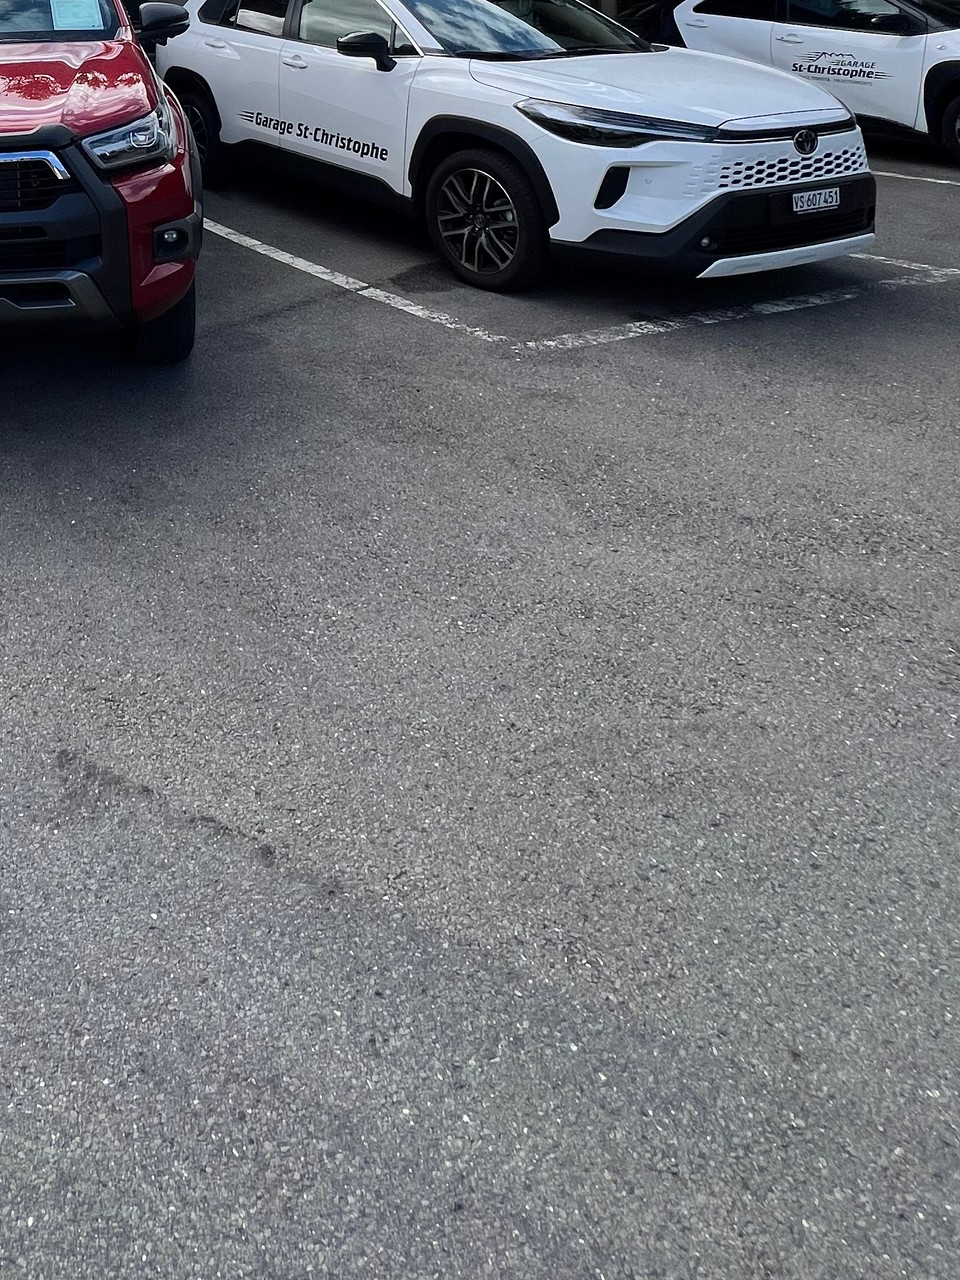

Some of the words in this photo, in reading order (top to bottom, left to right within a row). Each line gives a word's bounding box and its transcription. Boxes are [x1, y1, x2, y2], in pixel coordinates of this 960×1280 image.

[792, 63, 874, 79] St-Christophe
[840, 60, 876, 69] GARAGE
[255, 112, 294, 135] Garage
[296, 122, 389, 161] St-Christophe
[794, 195, 805, 210] VS
